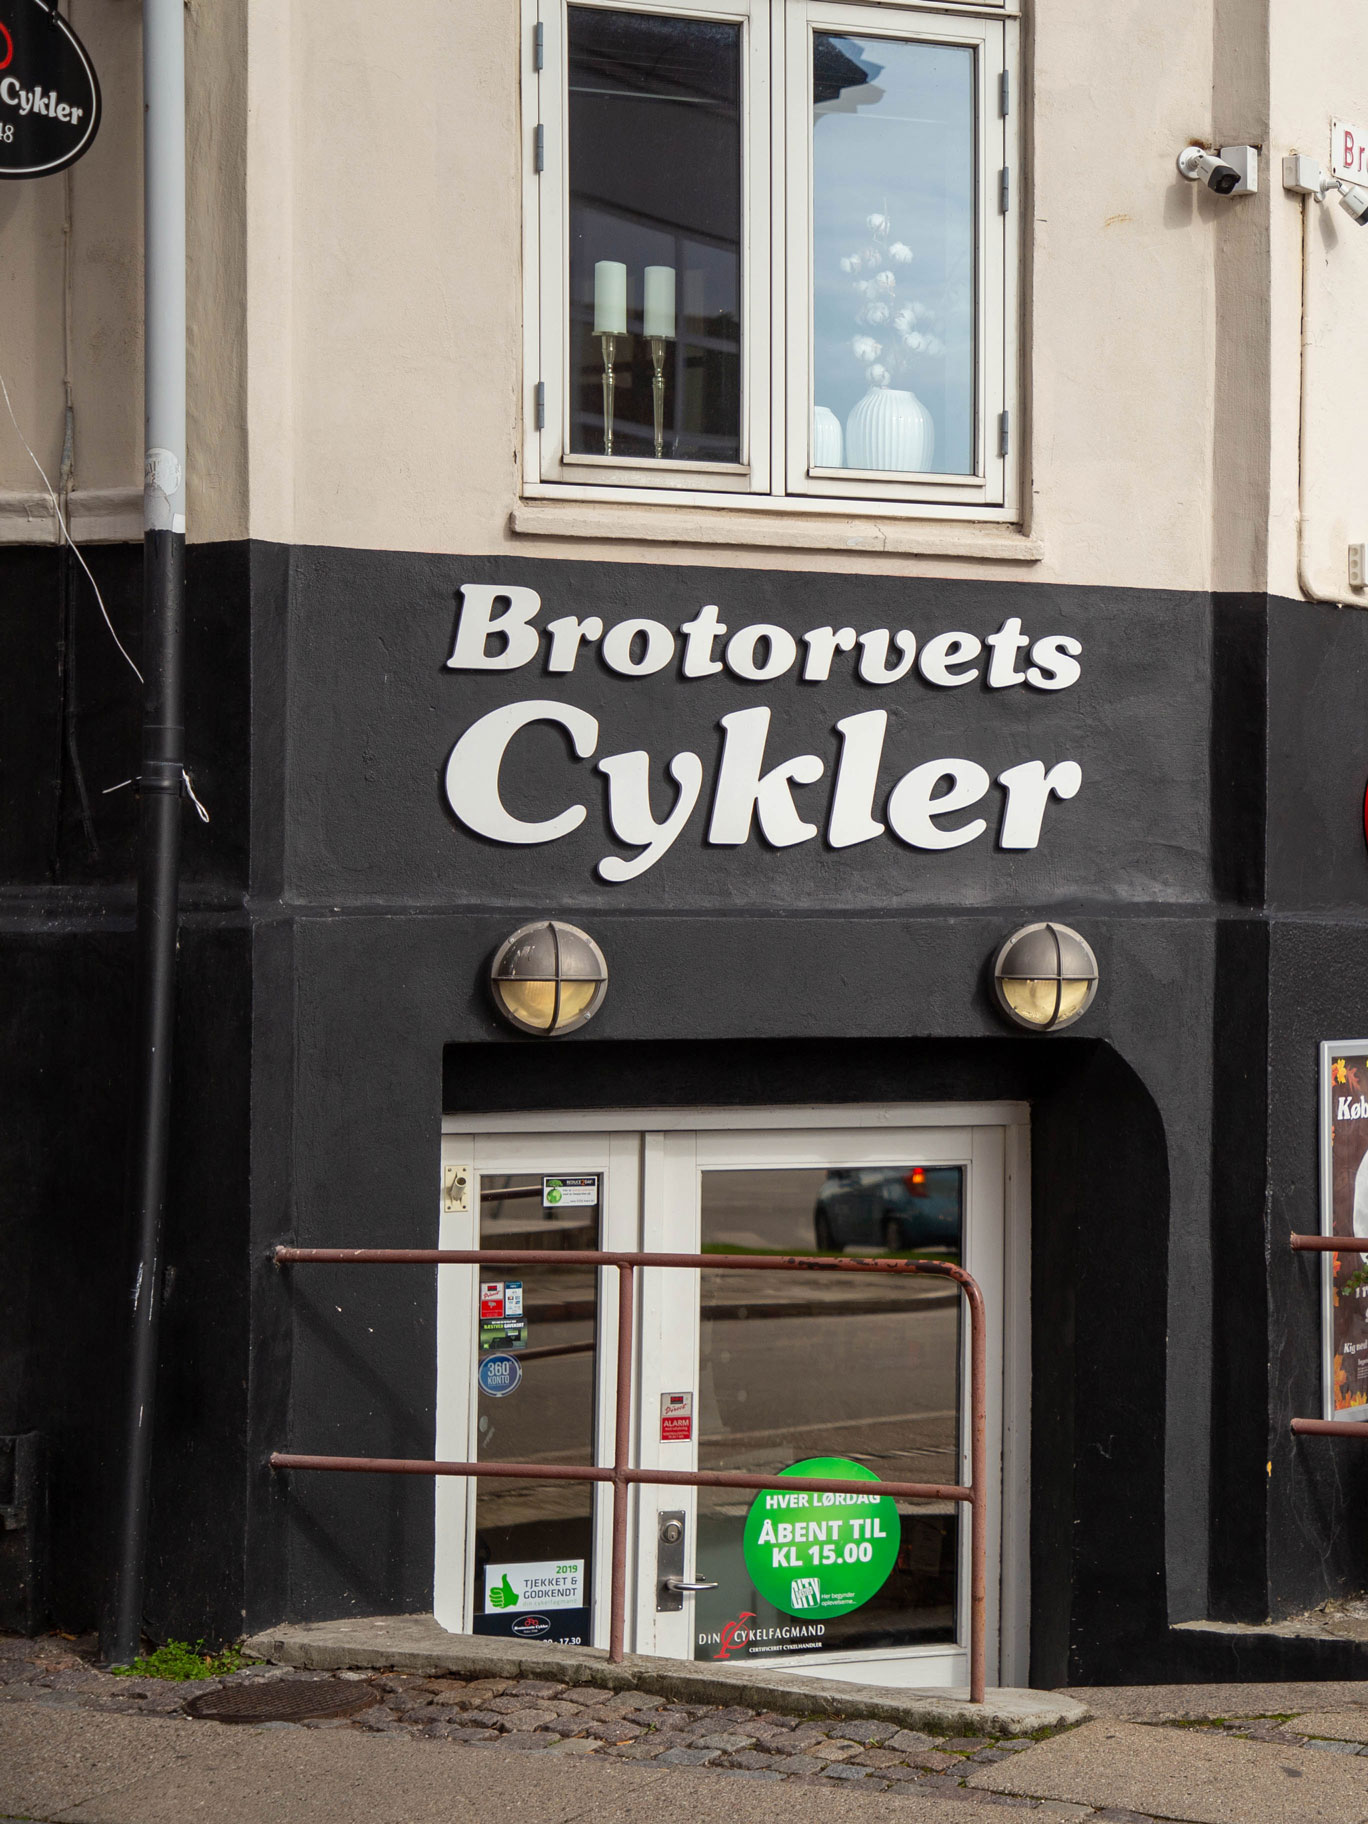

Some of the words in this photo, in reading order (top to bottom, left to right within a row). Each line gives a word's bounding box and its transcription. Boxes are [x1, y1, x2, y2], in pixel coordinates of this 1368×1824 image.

[1, 77, 83, 125] Cykler
[446, 583, 1082, 690] Brotorvets
[445, 699, 1082, 882] Cykler
[663, 1419, 690, 1428] ALARM
[765, 1493, 810, 1510] HVER
[813, 1492, 881, 1508] LØRDAG
[757, 1519, 843, 1545] ÅBENT
[849, 1518, 887, 1539] TIL
[772, 1546, 803, 1568] KL
[808, 1542, 873, 1565] 15.00
[556, 1564, 578, 1574] 2019
[523, 1577, 568, 1589] TJEKKET
[570, 1576, 578, 1585] &
[523, 1587, 578, 1599] GODKENDT
[698, 1632, 720, 1645] DIN
[734, 1624, 826, 1642] CYKELFAGMAND
